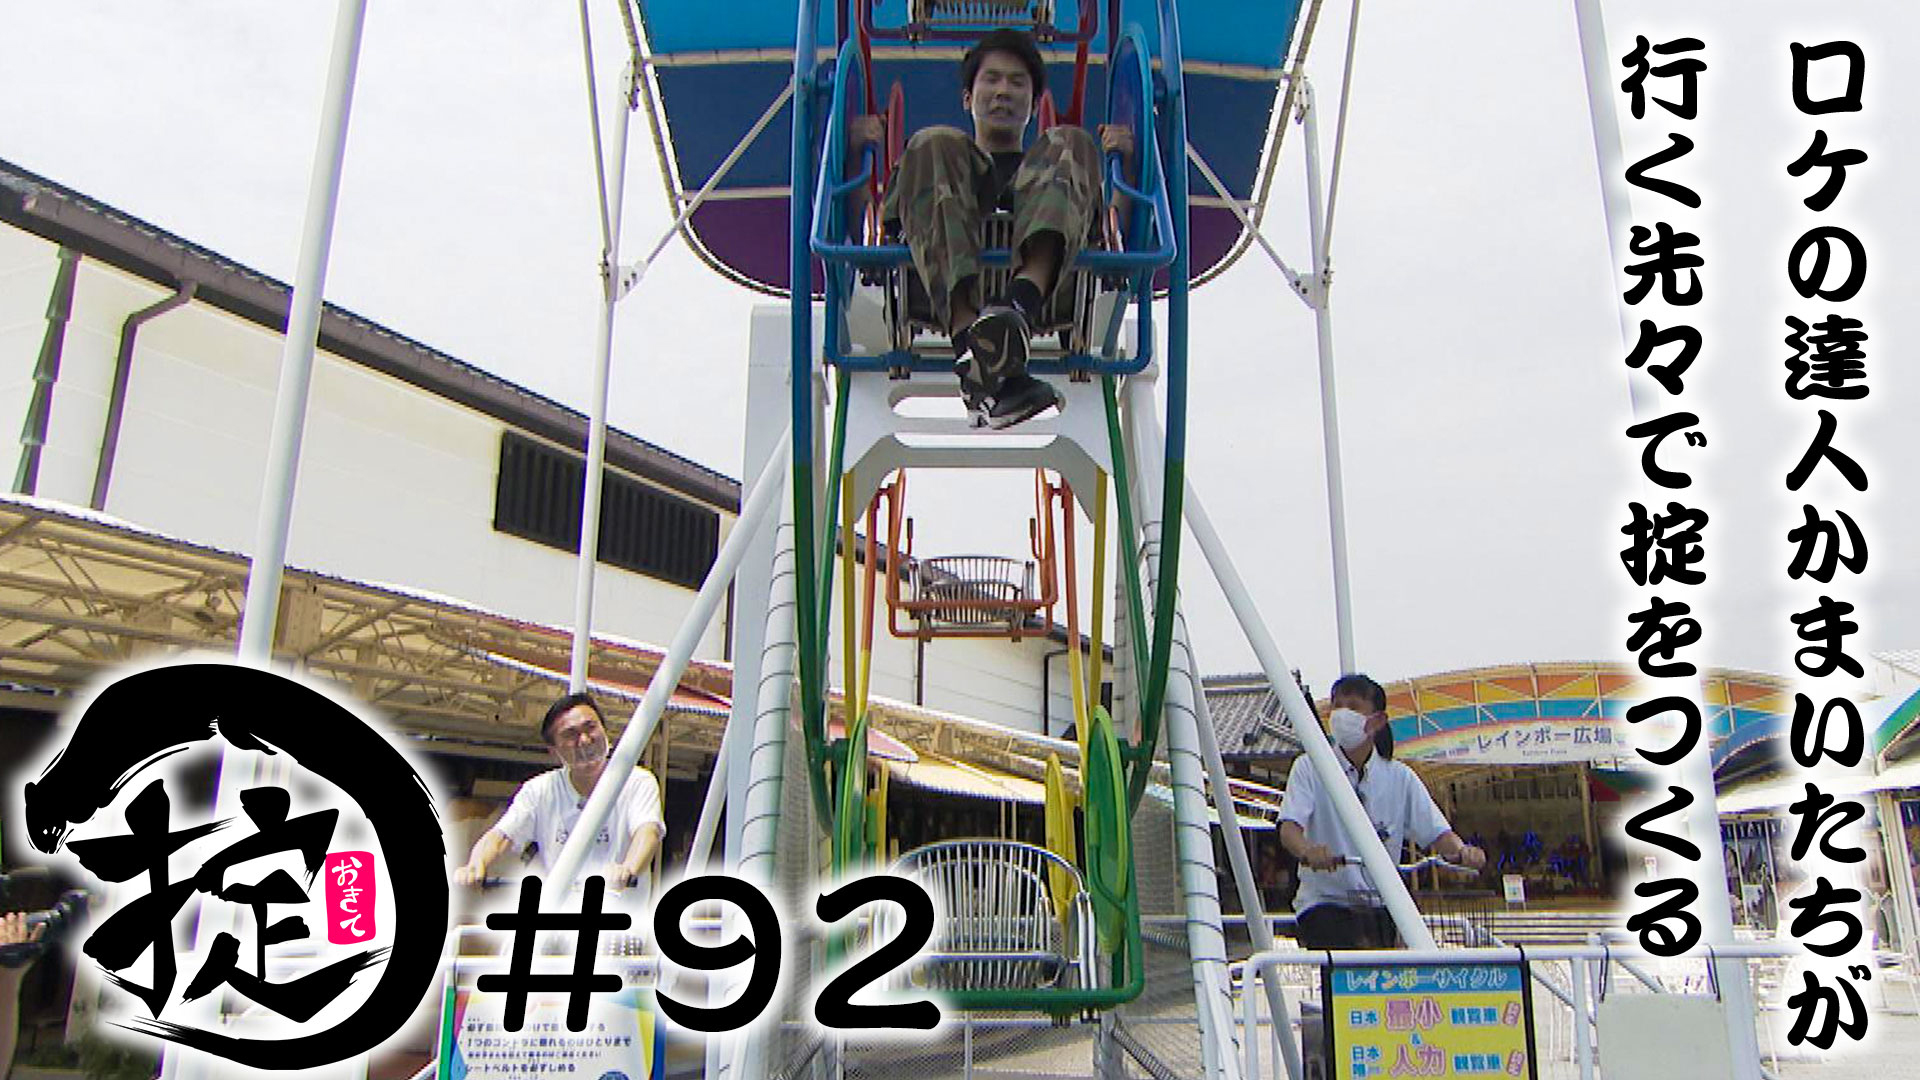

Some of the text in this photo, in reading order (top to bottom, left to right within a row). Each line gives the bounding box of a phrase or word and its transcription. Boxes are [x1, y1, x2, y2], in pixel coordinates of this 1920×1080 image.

[1477, 726, 1613, 753] レインボー広場
[1346, 968, 1507, 991] レインボーサイクル
[1350, 1010, 1379, 1025] 日本
[1386, 998, 1442, 1030] 最小
[1352, 1046, 1380, 1061] 日本
[1390, 1045, 1446, 1076] 人力
